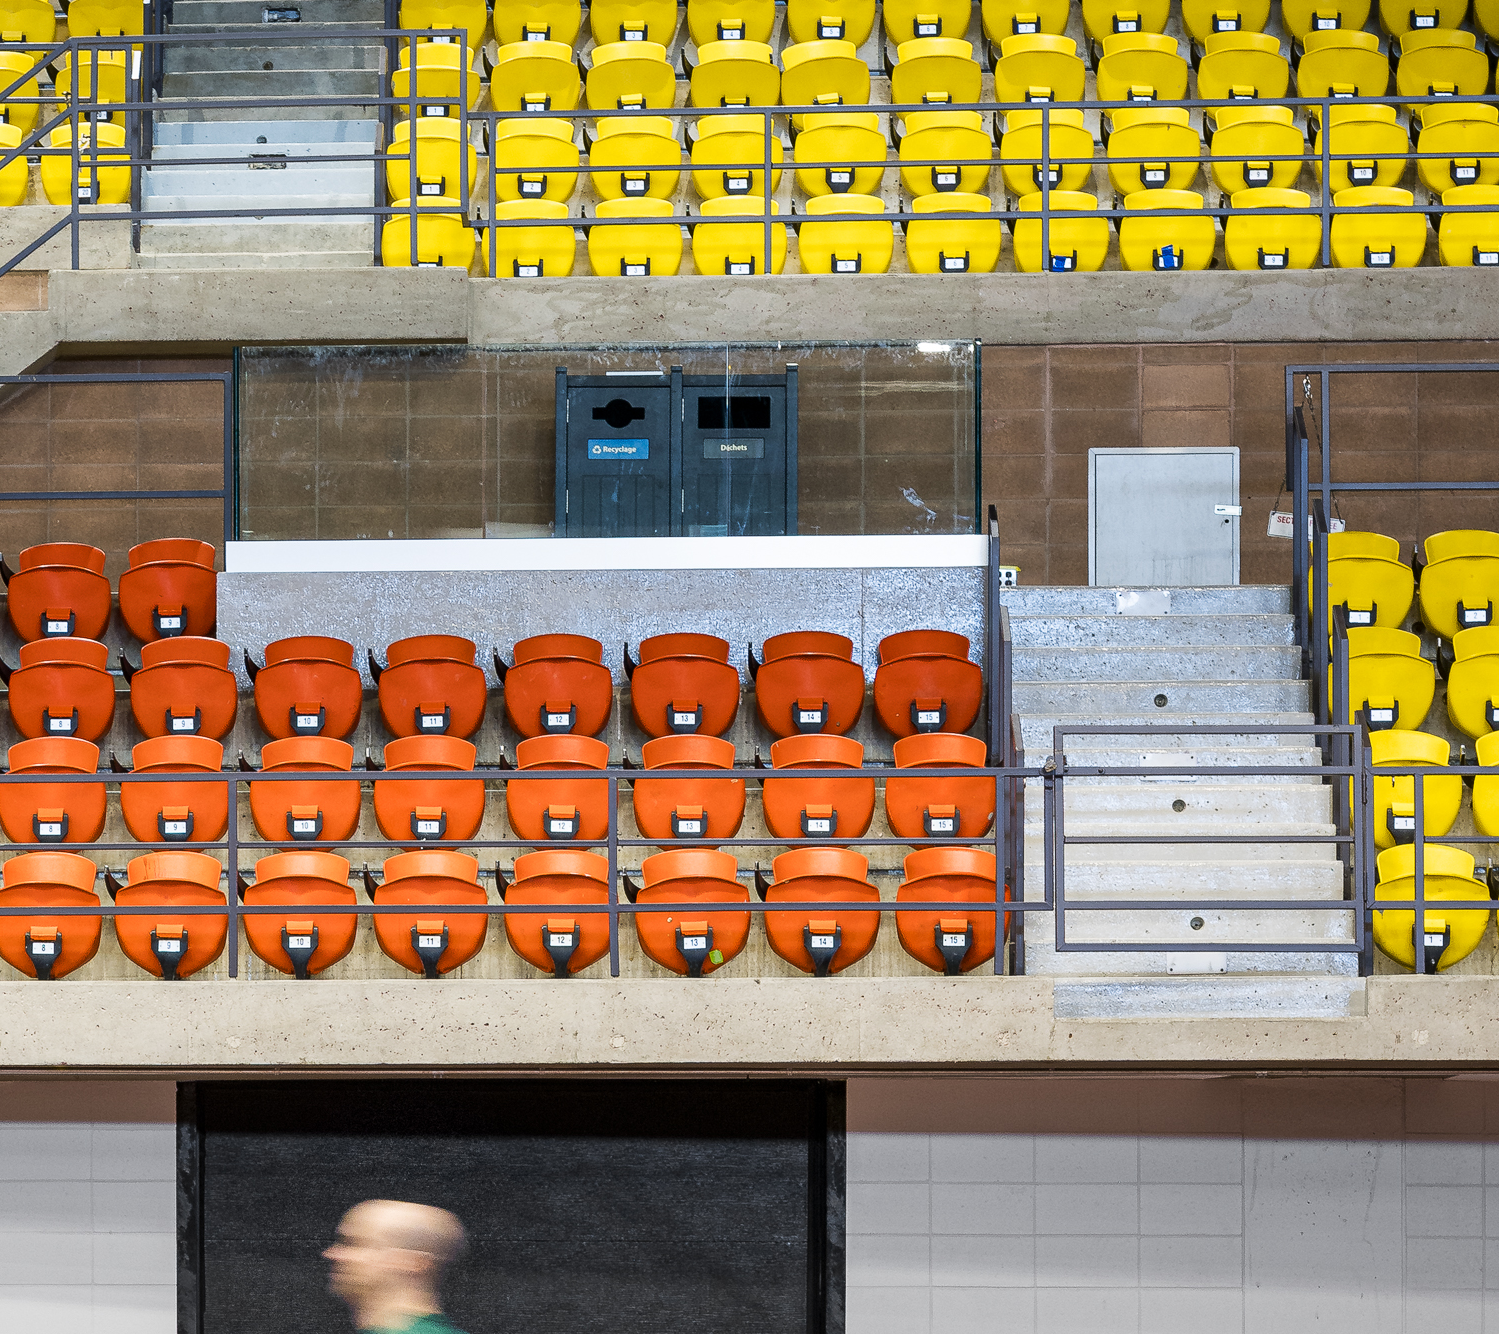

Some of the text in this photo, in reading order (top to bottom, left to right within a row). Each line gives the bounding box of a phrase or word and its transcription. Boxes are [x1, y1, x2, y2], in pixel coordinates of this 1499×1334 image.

[603, 445, 637, 454] Recyclage
[303, 717, 311, 725] 10
[429, 717, 437, 725] 11
[555, 715, 563, 723] 12
[681, 714, 689, 723] 13
[925, 713, 933, 721] 15
[301, 821, 309, 830] 10
[558, 822, 566, 830] 12
[686, 822, 694, 830] 13
[938, 820, 947, 829] 15
[296, 937, 304, 946] 10
[426, 937, 434, 945] 11
[557, 935, 565, 944] 12
[690, 938, 699, 947] 13
[950, 935, 958, 944] 15
